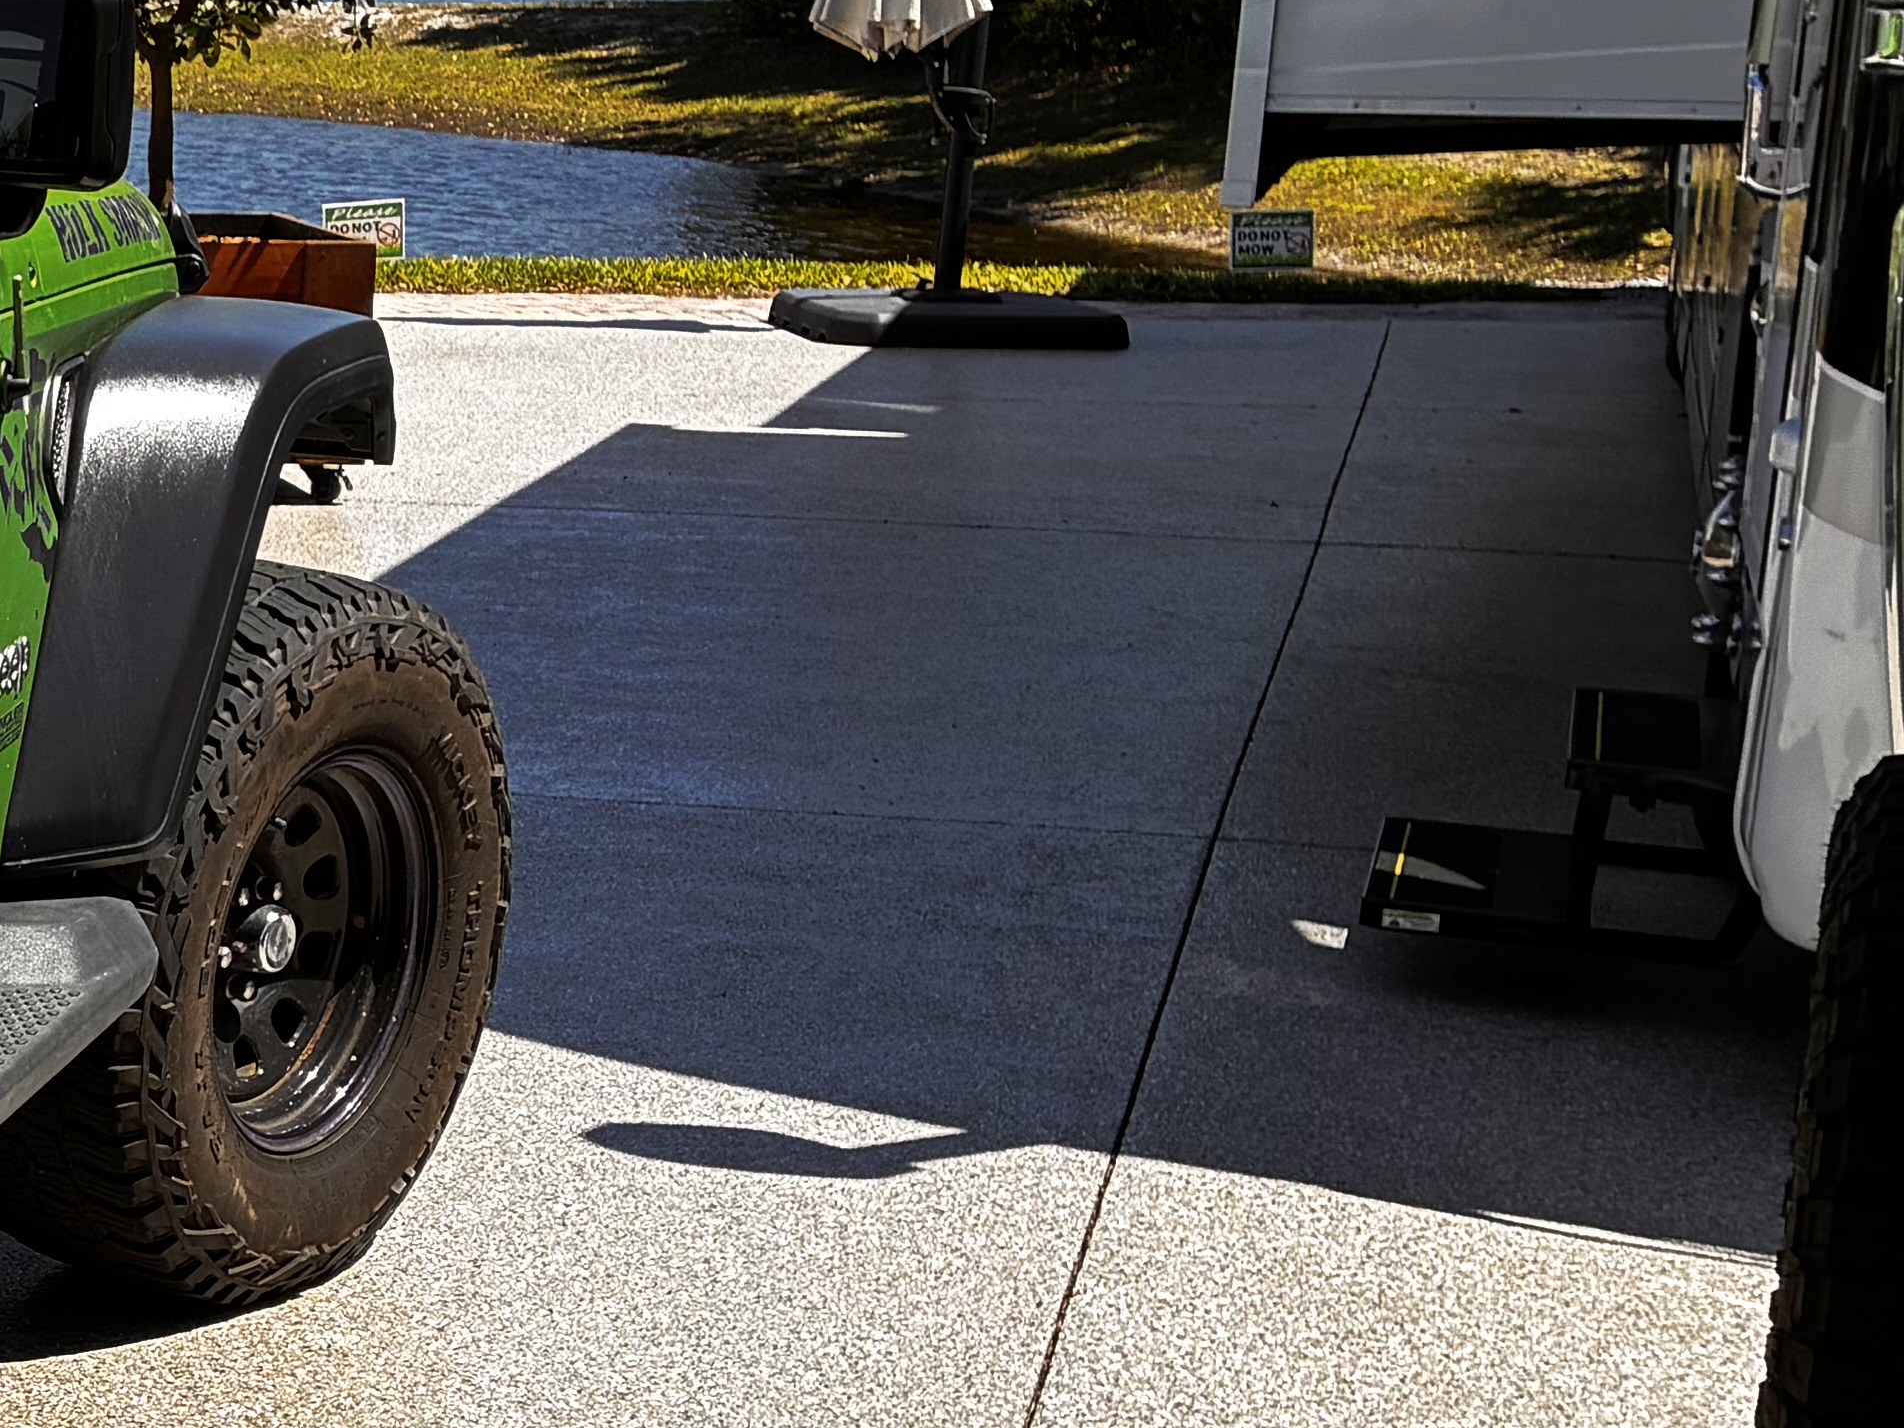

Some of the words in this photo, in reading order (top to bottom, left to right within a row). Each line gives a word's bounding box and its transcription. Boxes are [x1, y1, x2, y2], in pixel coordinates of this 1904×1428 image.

[332, 205, 398, 221] Please
[352, 220, 382, 234] NOT
[1237, 230, 1258, 242] DO
[1260, 228, 1290, 242] NOT
[1237, 244, 1275, 256] MOW
